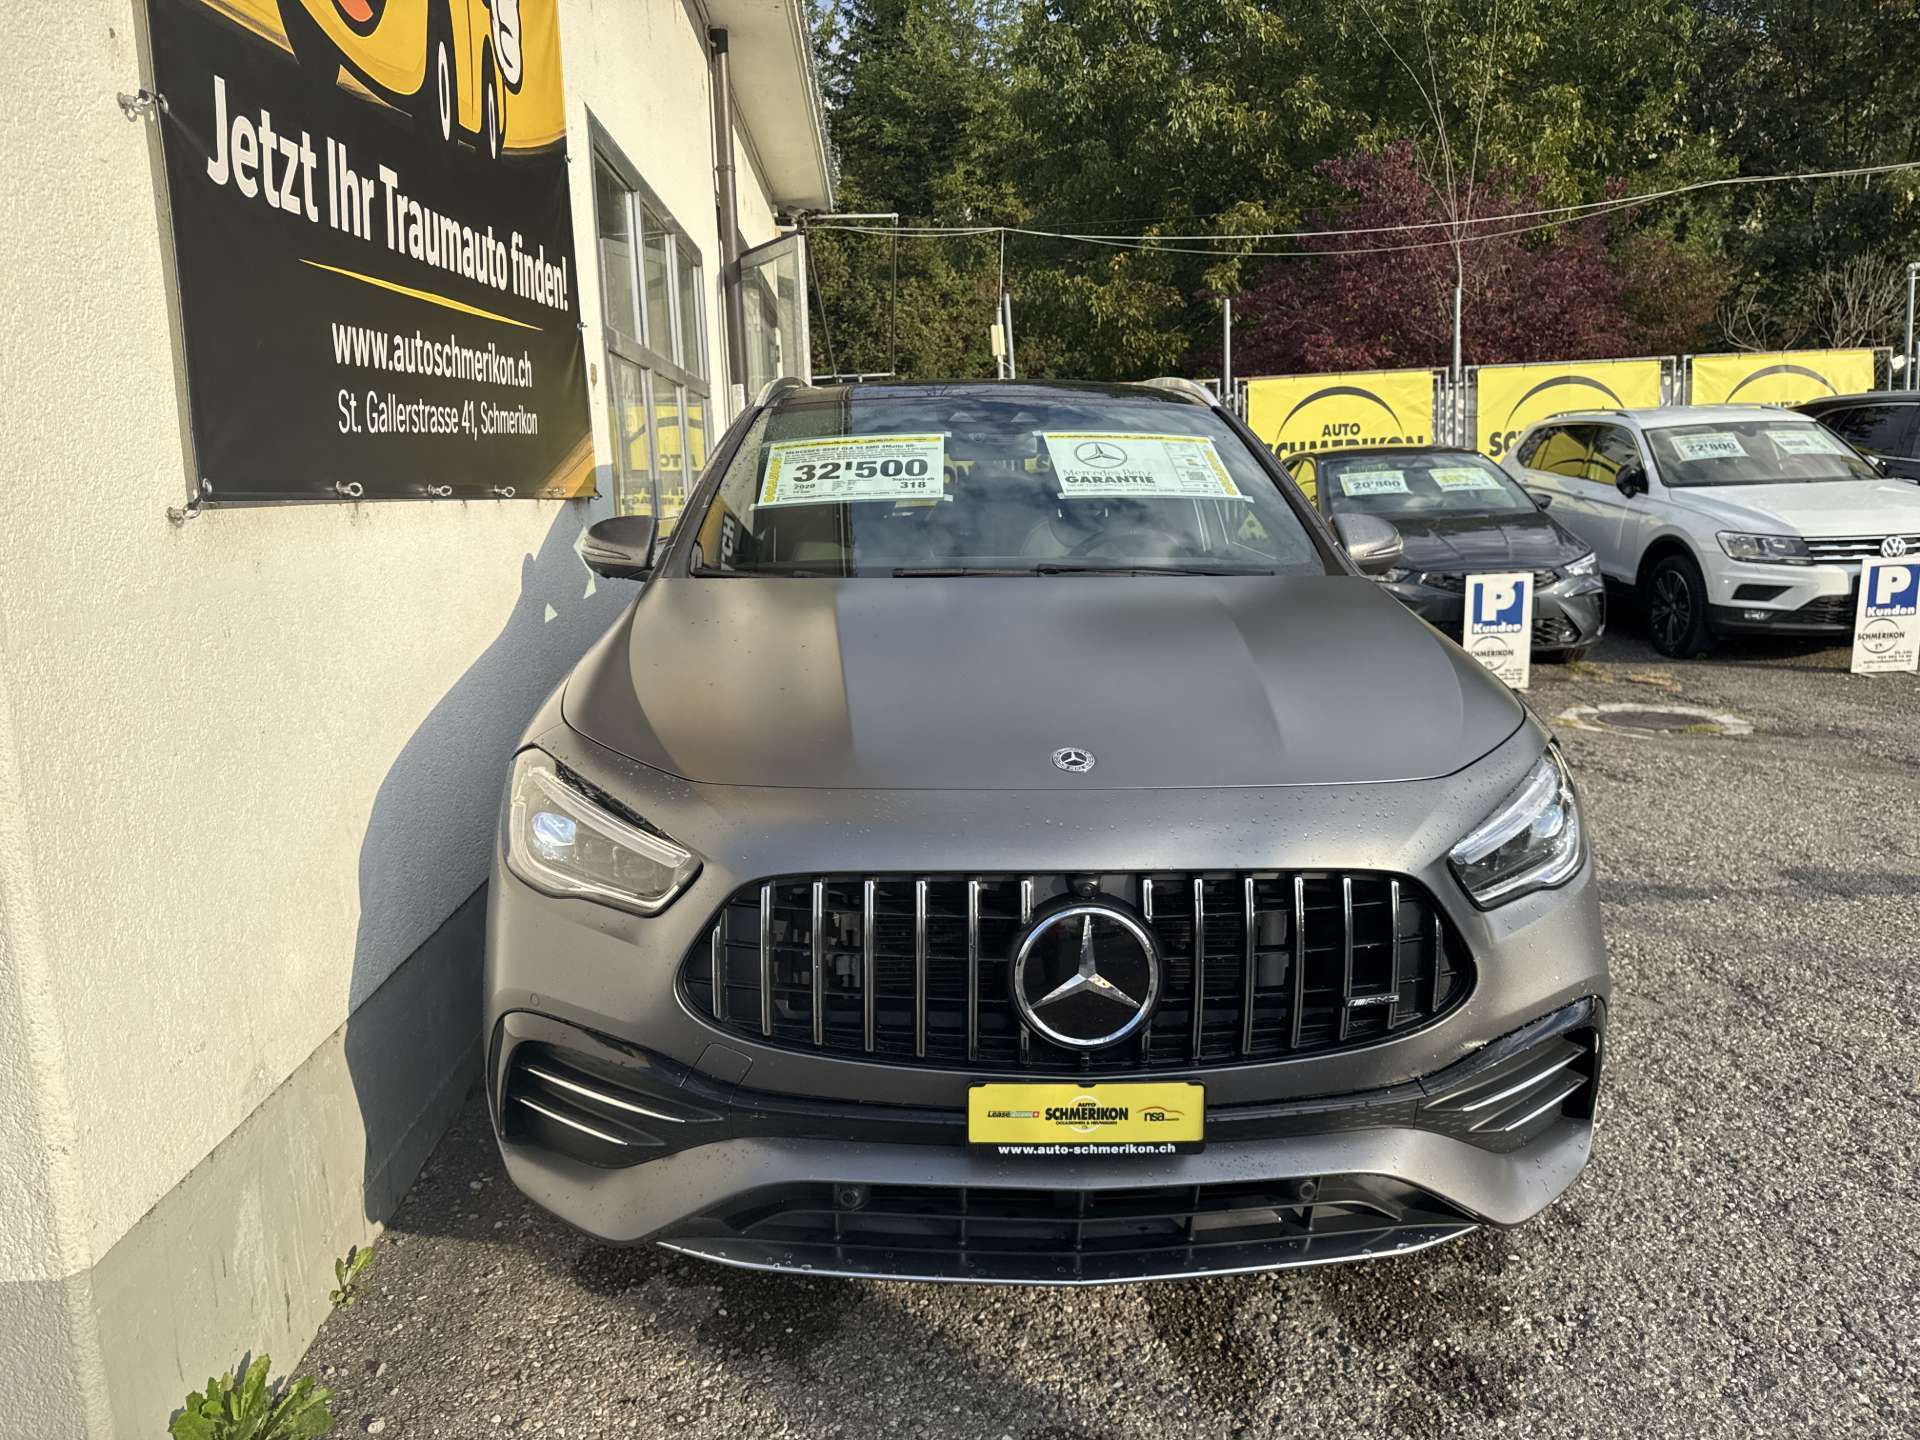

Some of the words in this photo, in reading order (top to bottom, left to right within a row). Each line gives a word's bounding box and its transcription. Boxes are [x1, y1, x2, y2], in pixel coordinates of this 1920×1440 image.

[207, 74, 319, 223] Jetzt
[327, 136, 375, 241] Ihr
[379, 163, 508, 291] Traumauto
[511, 231, 569, 312] finden!
[331, 322, 533, 388] www.autoschmerikon.ch
[338, 389, 362, 434] St.
[366, 390, 459, 434] Gallerstrasse
[461, 400, 478, 440] 41,
[480, 401, 538, 435] Schmerikon
[1321, 422, 1360, 437] AUTO
[792, 459, 928, 482] 32'500
[900, 481, 927, 489] 318
[1065, 476, 1155, 484] GARANTIE
[1876, 566, 1912, 605] P
[1481, 581, 1516, 621] P
[1866, 604, 1916, 617] Kunden
[1472, 621, 1522, 634] Kunden
[1858, 631, 1906, 641] SCHMERIKON
[1045, 1107, 1129, 1121] SCHMERIKON
[1144, 1112, 1165, 1122] nsa
[997, 1143, 1176, 1155] www.auto-schmerikon.ch
